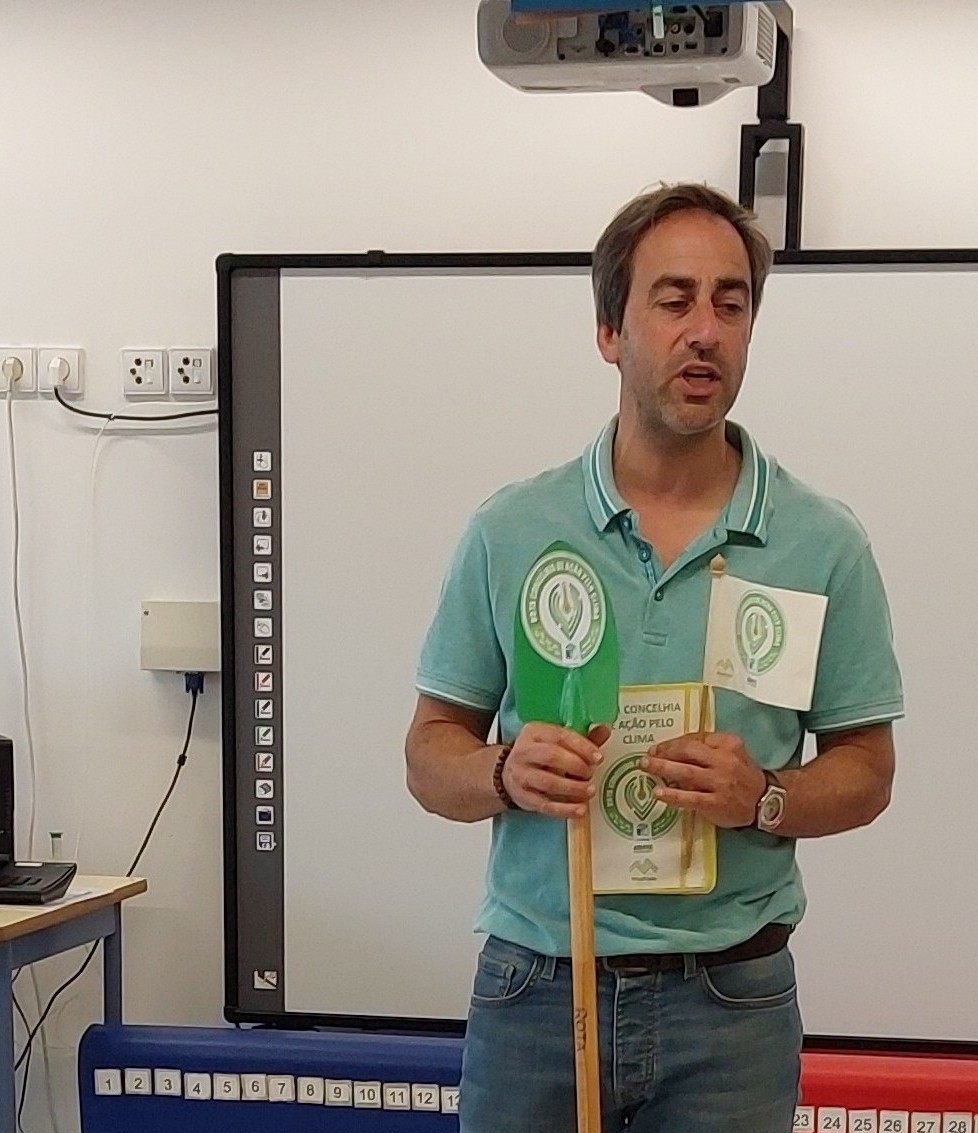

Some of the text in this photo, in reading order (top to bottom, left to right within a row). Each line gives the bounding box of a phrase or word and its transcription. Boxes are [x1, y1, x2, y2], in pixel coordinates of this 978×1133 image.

[623, 702, 682, 715] CONCELHIA
[618, 717, 647, 731] AÇÃO
[649, 717, 675, 729] PELO
[622, 733, 655, 745] CLIMA
[105, 1078, 112, 1091] 1
[134, 1077, 144, 1090] 2
[164, 1078, 173, 1091] 3
[192, 1082, 201, 1095] 4
[223, 1081, 232, 1093] 5
[251, 1080, 260, 1092] 6
[277, 1082, 286, 1095] 7
[306, 1084, 315, 1097] 8
[333, 1086, 342, 1099] 9
[359, 1088, 376, 1101] 10
[389, 1091, 405, 1104] 11
[417, 1092, 433, 1105] 12
[793, 1113, 809, 1127] 23
[823, 1116, 841, 1130] 24
[853, 1118, 872, 1132] 25
[883, 1119, 902, 1132] 26
[916, 1120, 936, 1133] 27
[948, 1120, 967, 1133] 28
